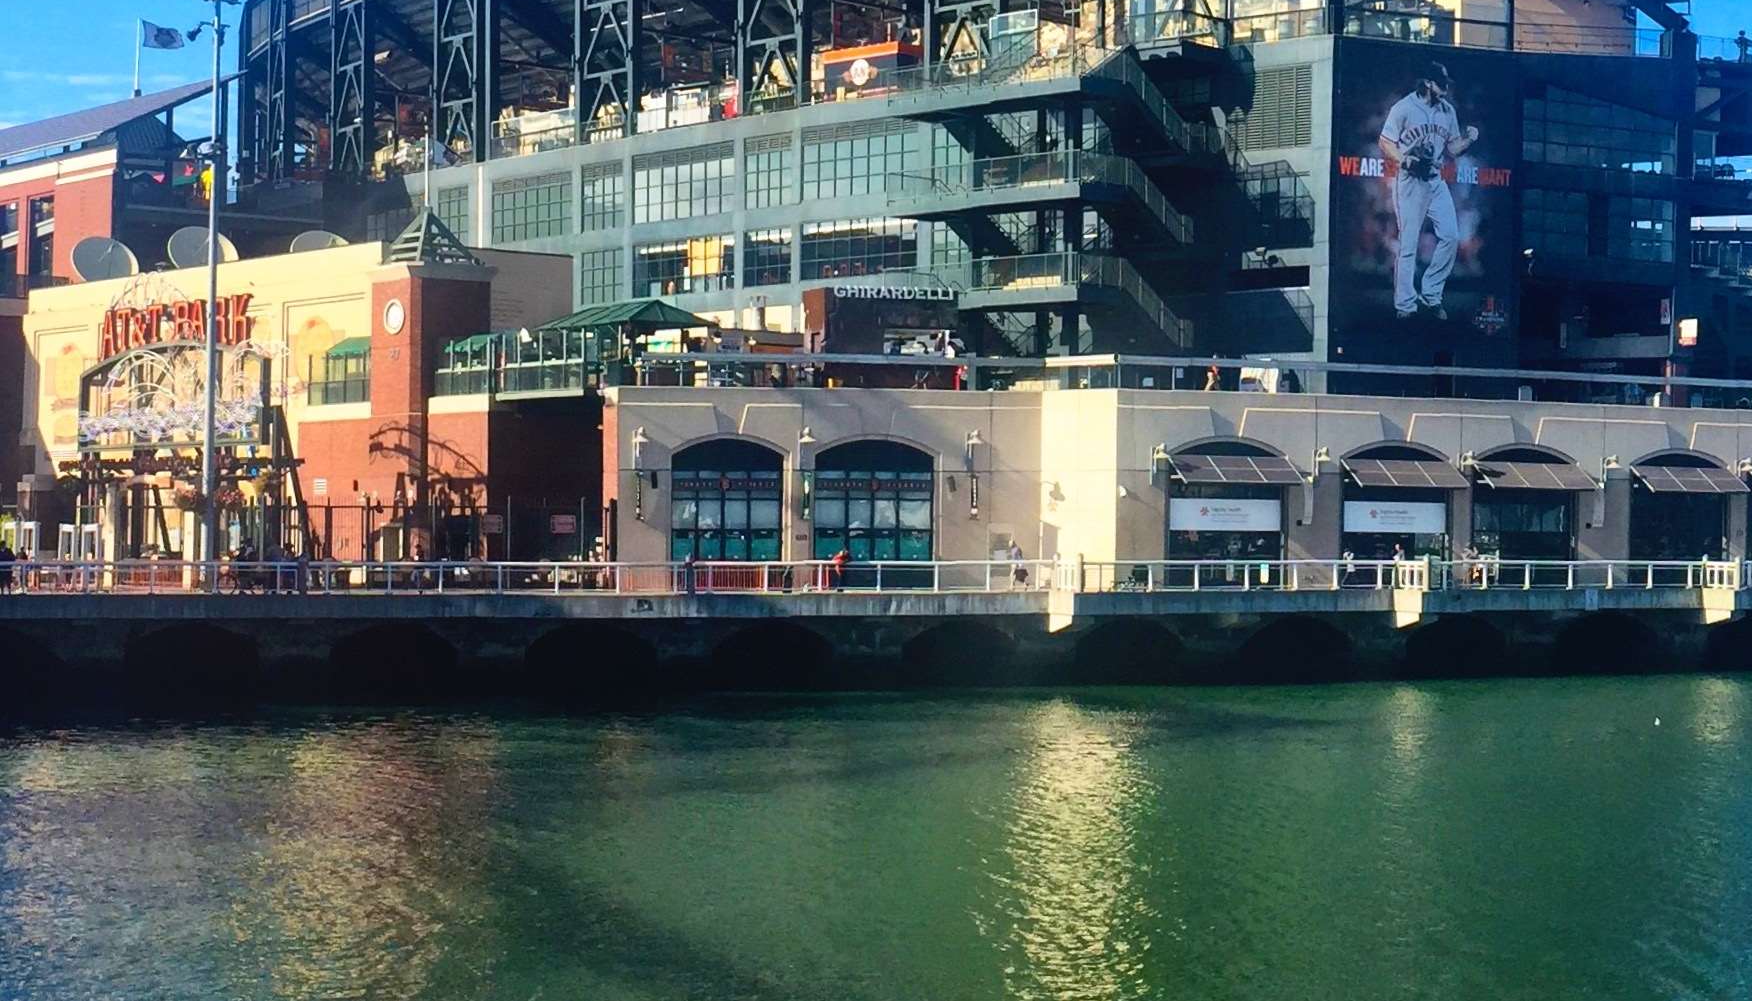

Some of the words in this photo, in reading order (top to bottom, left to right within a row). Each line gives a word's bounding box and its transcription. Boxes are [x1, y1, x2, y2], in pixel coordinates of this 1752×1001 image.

[833, 284, 954, 300] GHIRARDELLI
[101, 303, 166, 362] AT&T
[173, 293, 254, 345] PARK
